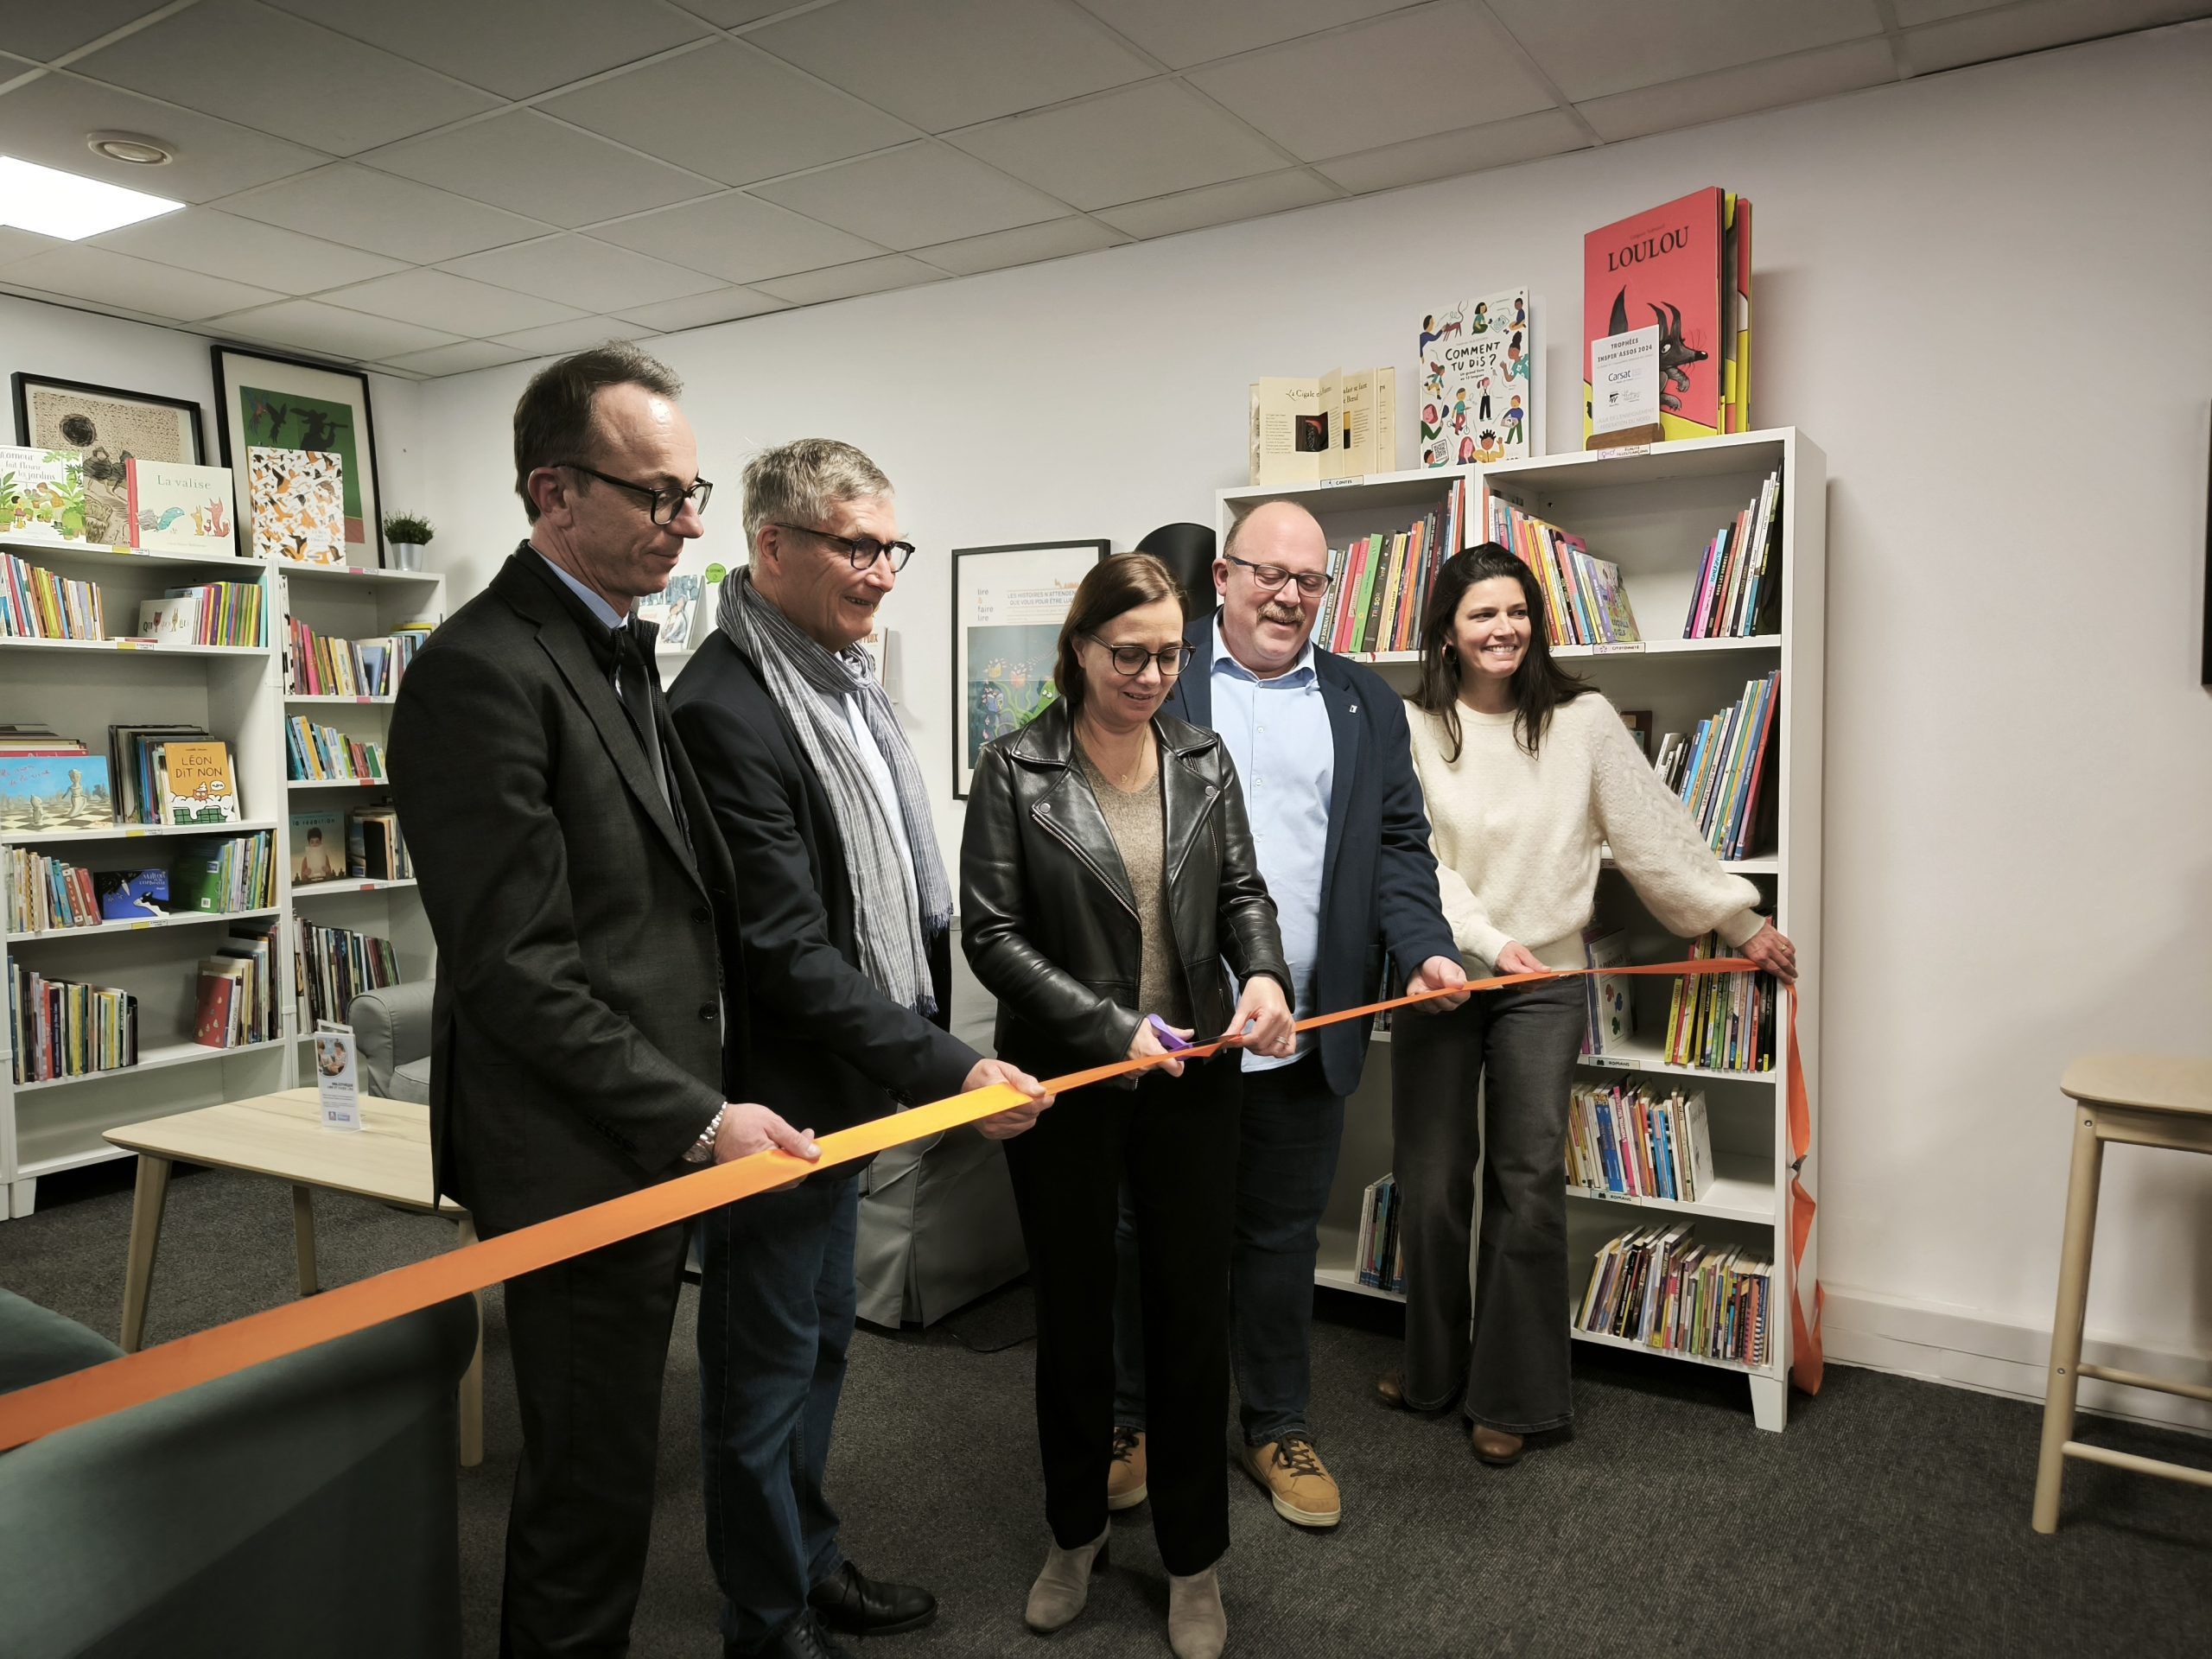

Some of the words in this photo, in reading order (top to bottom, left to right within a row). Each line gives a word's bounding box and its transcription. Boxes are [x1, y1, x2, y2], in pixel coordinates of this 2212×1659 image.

[1608, 226, 1689, 272] LOULOU
[1611, 337, 1639, 349] TROPHÉES
[1637, 344, 1653, 353] 2024
[1445, 341, 1501, 361] COMMENT
[1452, 361, 1465, 372] TU
[1608, 370, 1631, 382] Carsat
[1296, 389, 1315, 399] Cigale
[28, 471, 55, 480] jardins
[156, 474, 171, 486] La
[175, 478, 212, 490] valise
[1320, 613, 1330, 635] JOURNAL
[181, 754, 213, 766] LÉON
[197, 766, 223, 777] NON
[66, 876, 79, 914] OLIVIA
